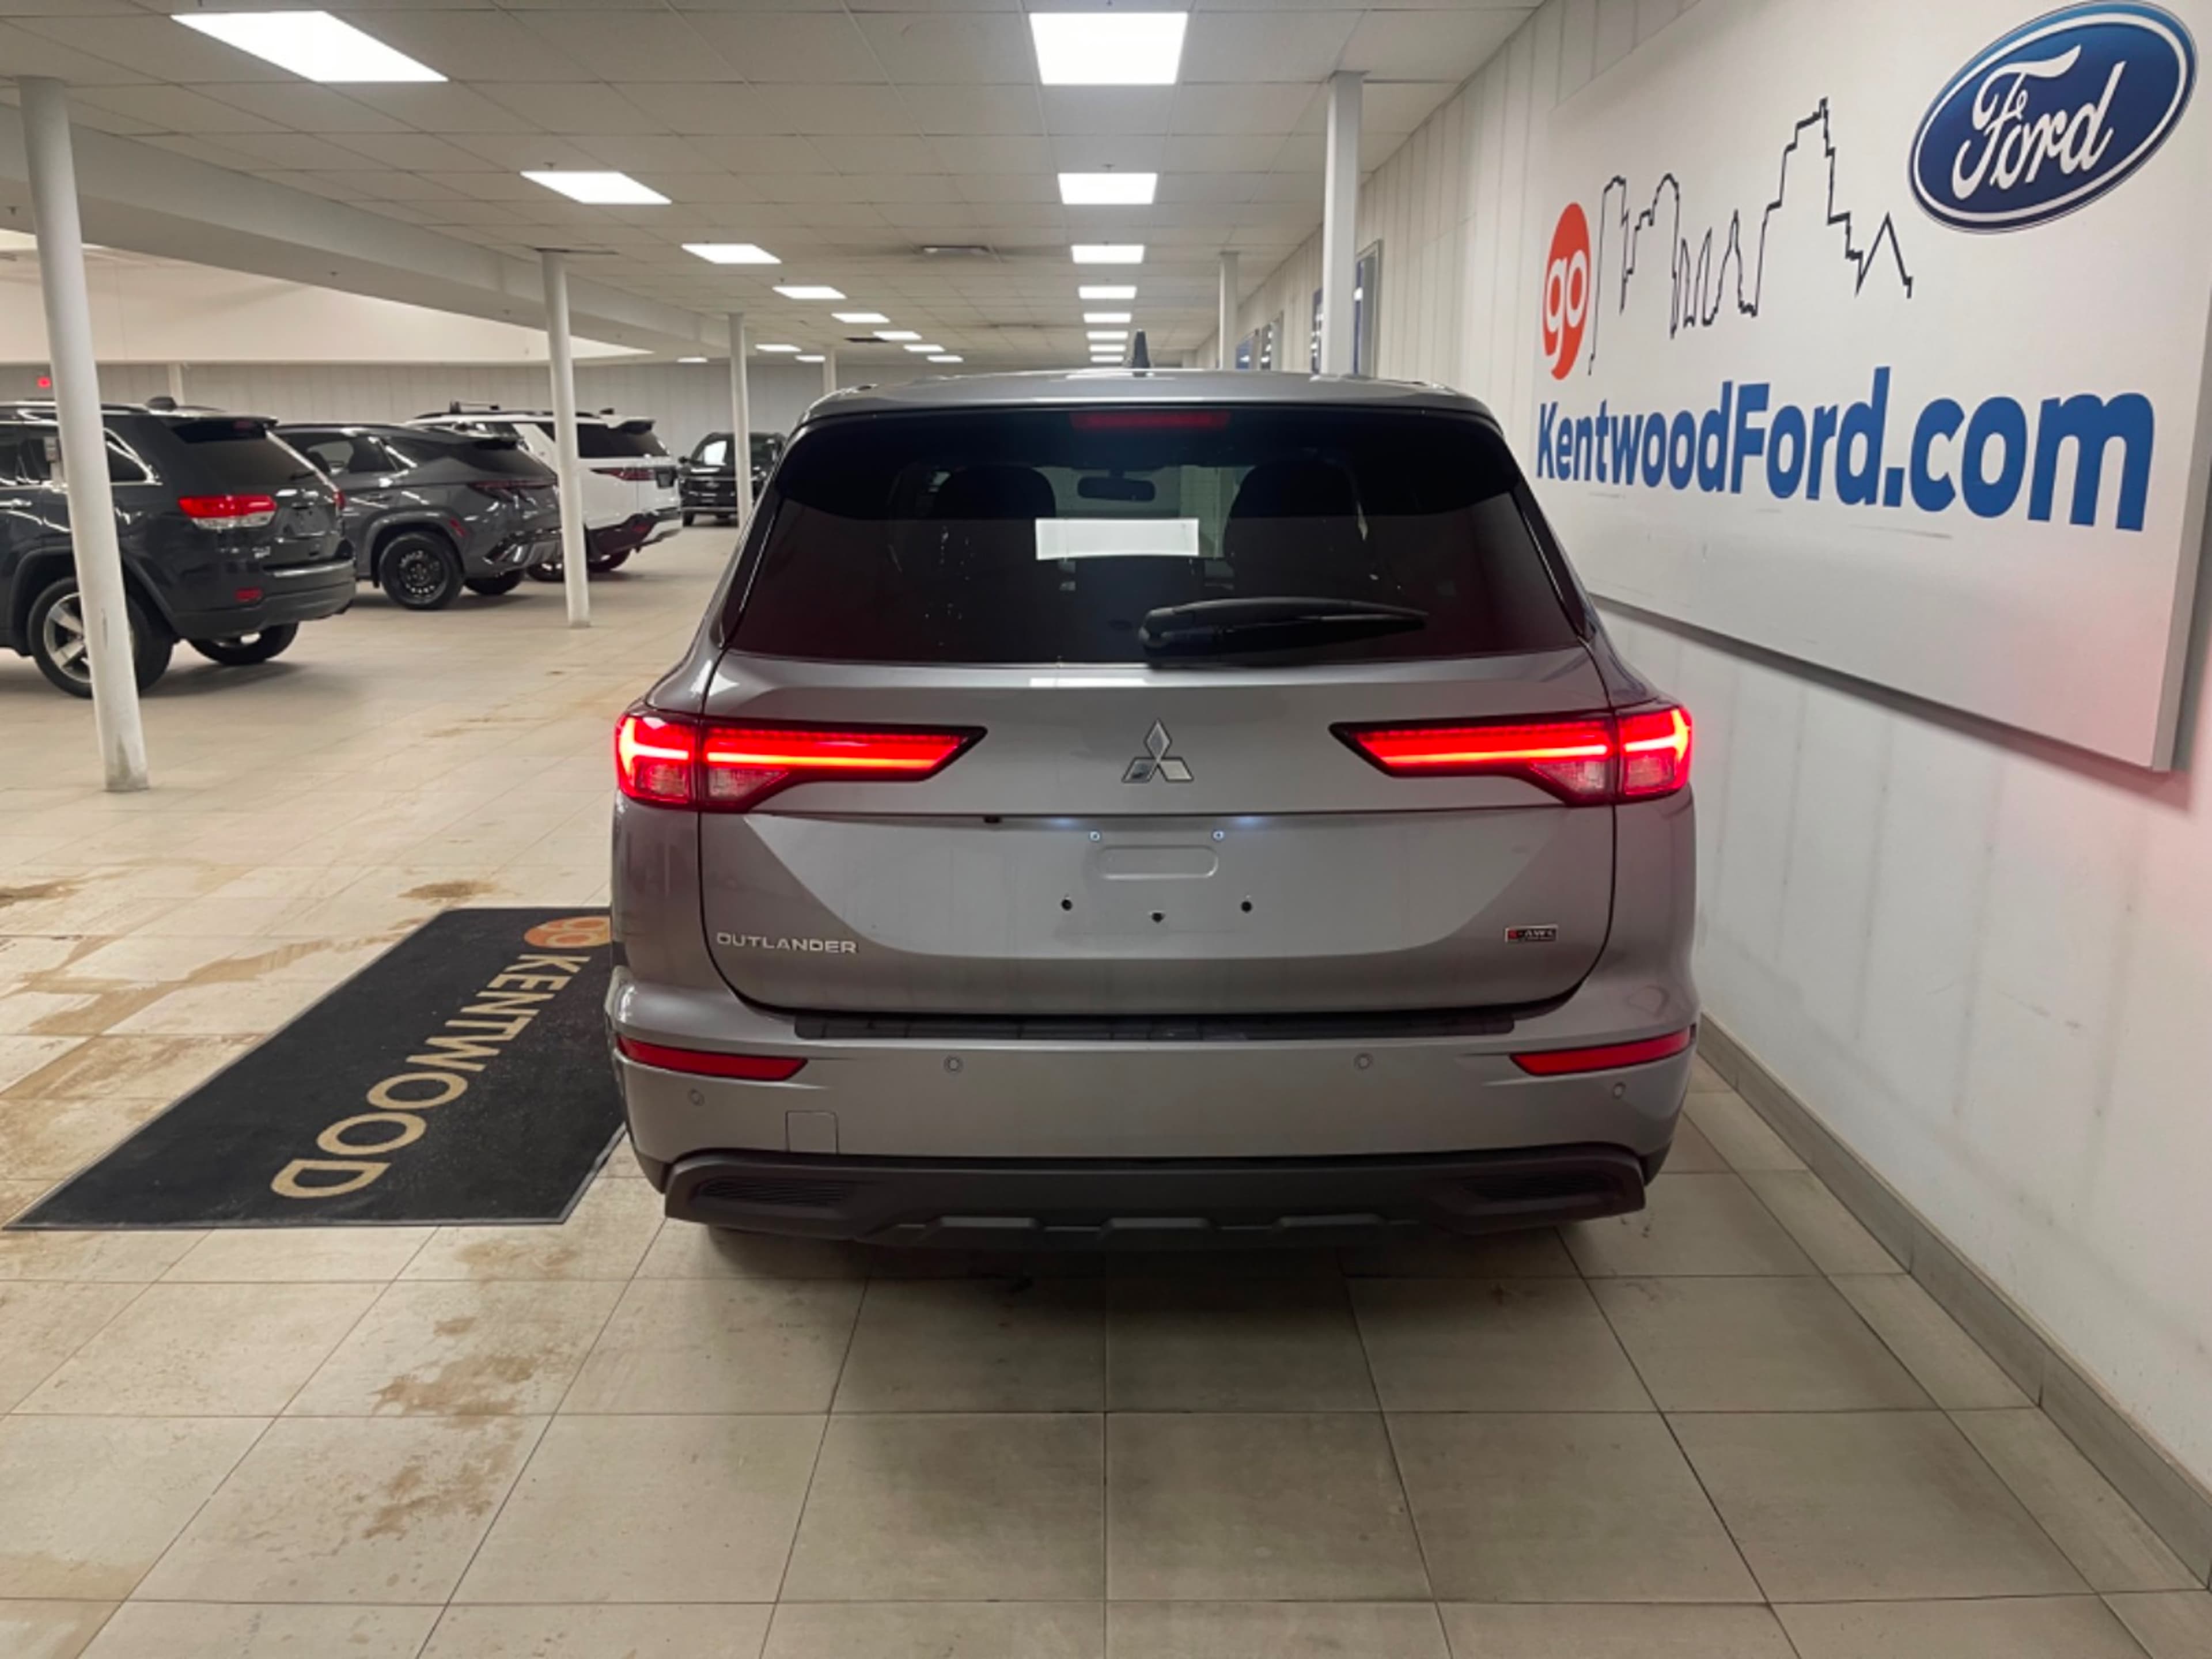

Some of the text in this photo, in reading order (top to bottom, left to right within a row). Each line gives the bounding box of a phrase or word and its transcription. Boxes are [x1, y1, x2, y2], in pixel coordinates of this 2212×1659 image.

[1952, 44, 2127, 200] Ford
[1546, 249, 1588, 373] go
[1536, 365, 2155, 532] KentwoodFord.com
[716, 931, 859, 954] OUTLANDER
[270, 953, 592, 1199] KENTWOOD
